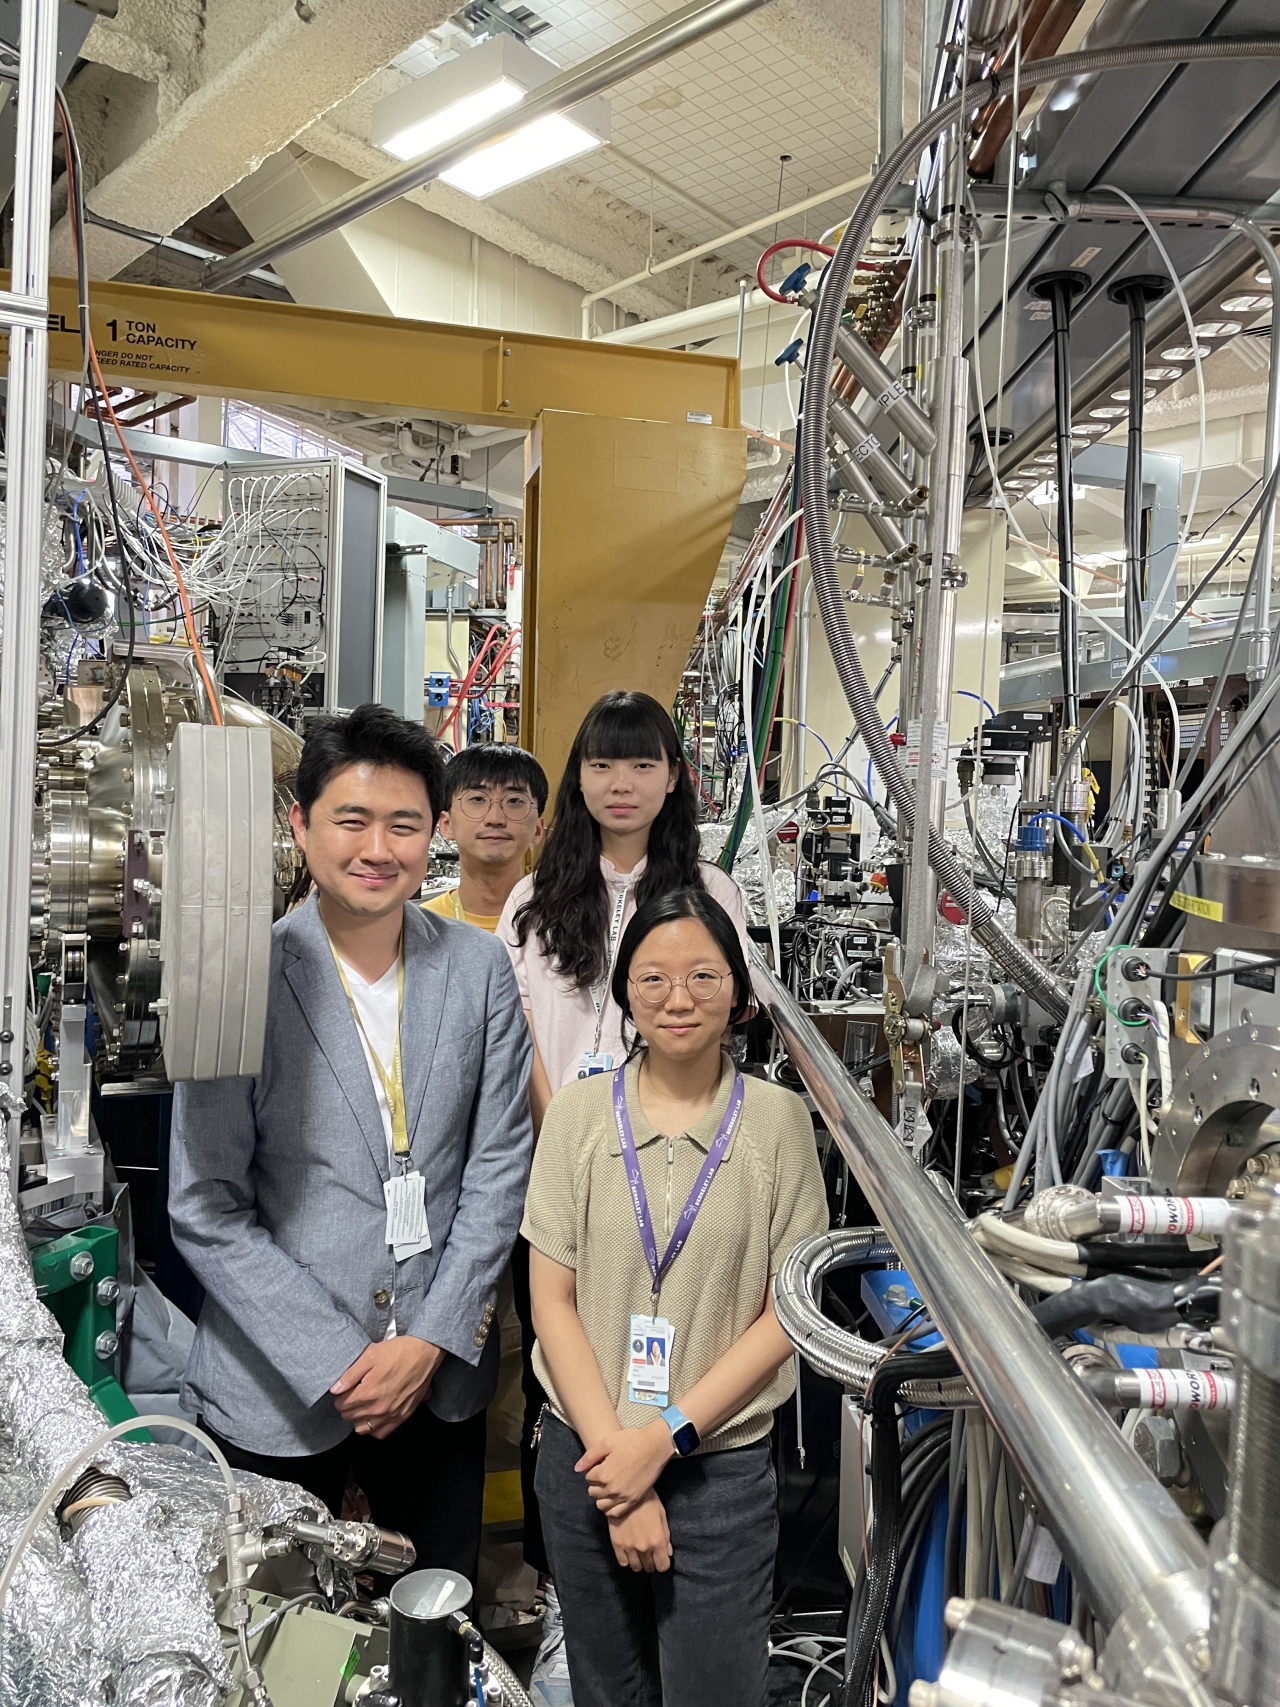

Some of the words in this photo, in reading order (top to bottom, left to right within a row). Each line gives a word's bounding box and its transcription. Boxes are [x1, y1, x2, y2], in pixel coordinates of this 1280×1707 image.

[106, 319, 117, 341] 1
[125, 320, 156, 334] TON
[125, 333, 198, 350] CAPACITY
[120, 359, 147, 369] RATED
[149, 362, 191, 374] CAPACITY
[610, 925, 619, 942] LAB
[615, 1111, 625, 1137] BERKELEY
[620, 1137, 628, 1149] LAB
[726, 1109, 739, 1135] BERKELEY
[694, 1178, 709, 1206] BERKELEY
[706, 1167, 715, 1179] LAB
[631, 1186, 642, 1214] BERKELEY
[637, 1214, 645, 1228] LAB
[674, 1240, 683, 1251] LAB
